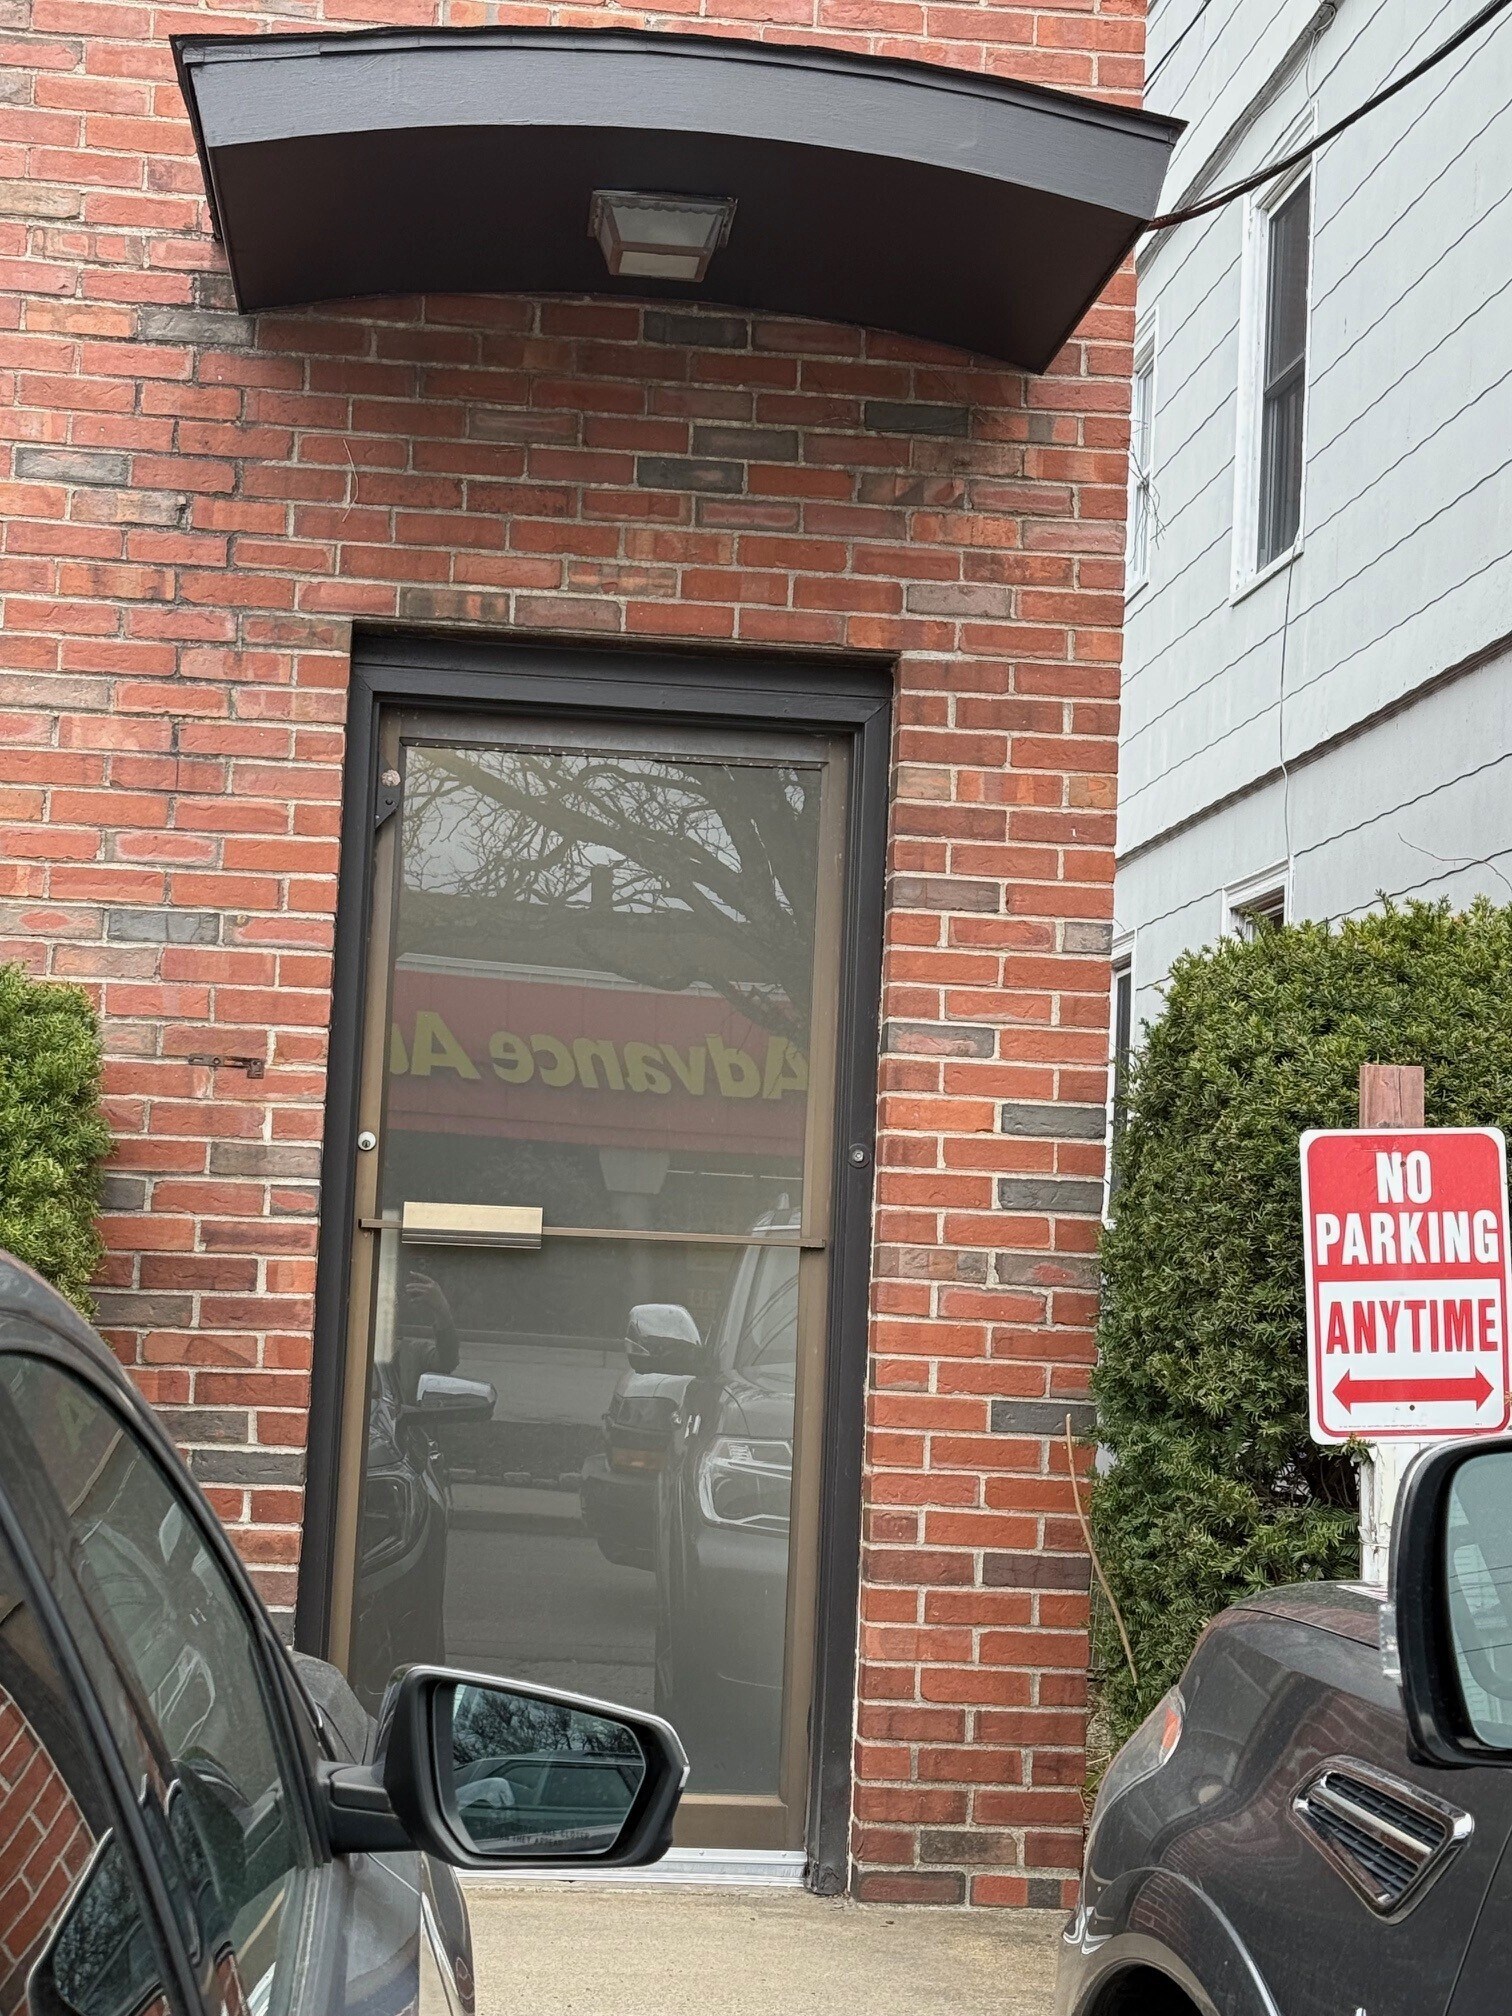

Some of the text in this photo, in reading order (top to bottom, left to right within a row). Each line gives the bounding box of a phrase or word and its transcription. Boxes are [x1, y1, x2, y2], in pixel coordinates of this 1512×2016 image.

[1376, 1151, 1432, 1204] NO
[1315, 1209, 1499, 1266] PARKING
[1326, 1299, 1498, 1354] ANYTIME
